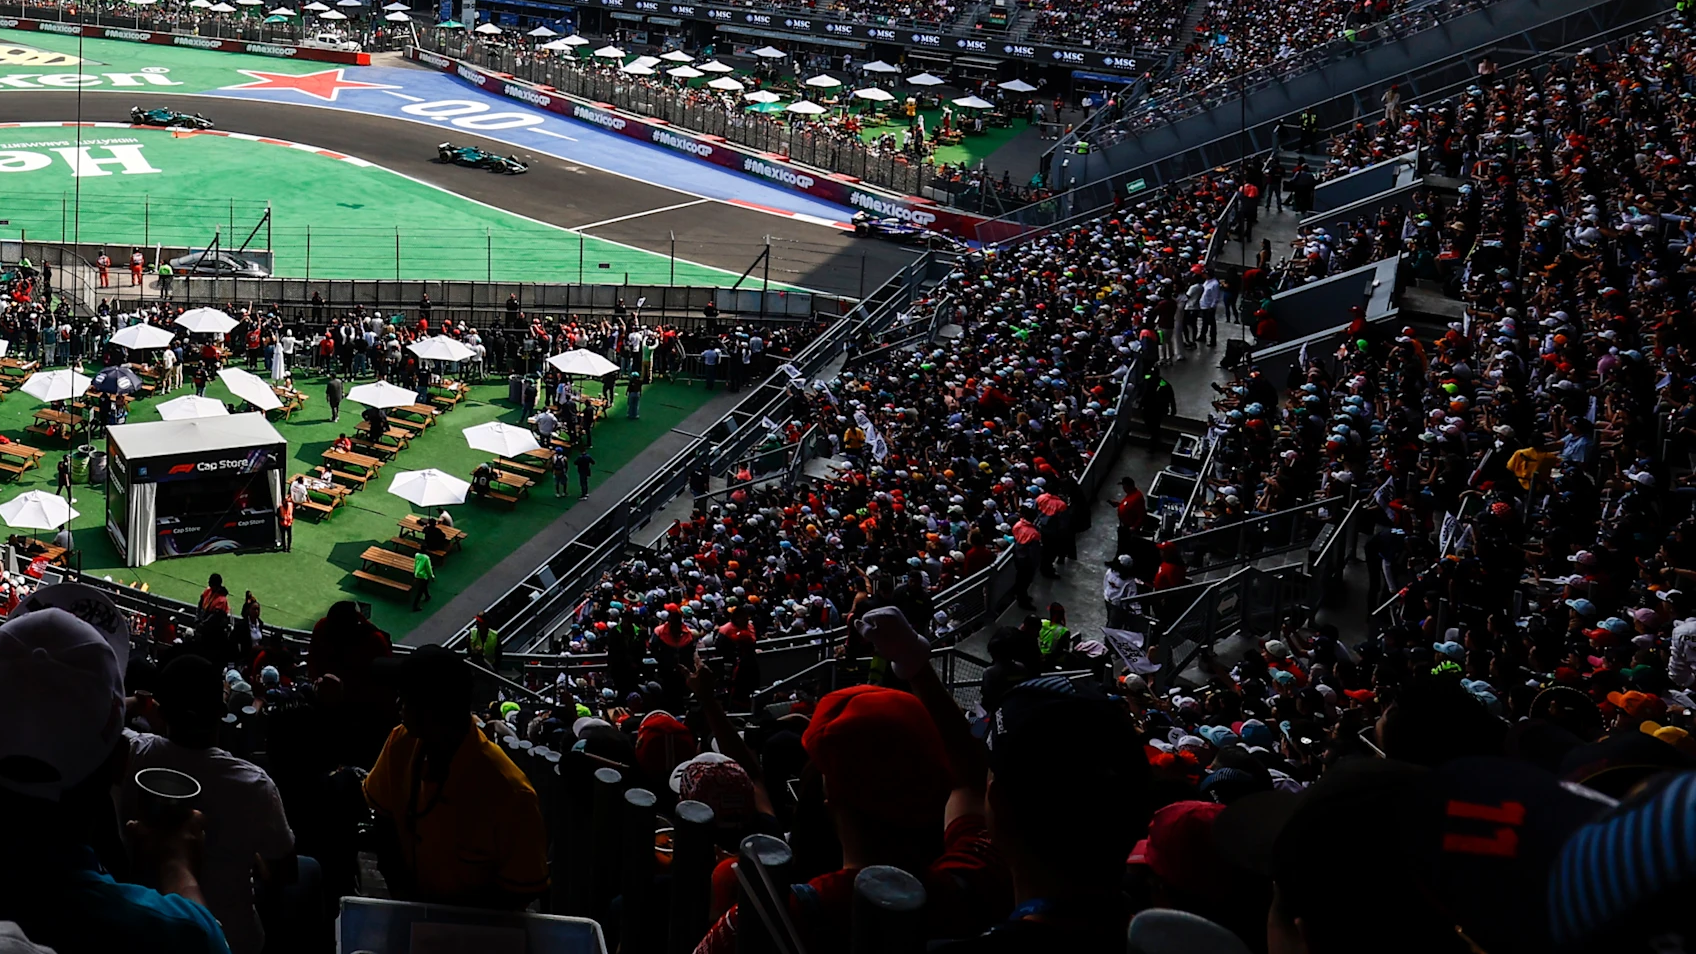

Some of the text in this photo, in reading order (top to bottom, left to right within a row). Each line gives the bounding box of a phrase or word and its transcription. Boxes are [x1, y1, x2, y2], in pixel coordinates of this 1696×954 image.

[104, 29, 151, 41] #MexicoGP
[174, 36, 222, 48] #MexicoGP
[246, 44, 297, 56] #MexicoGP
[418, 53, 450, 68] #MexicoGP
[458, 64, 487, 86] #MexicoGP
[504, 84, 551, 106] #MexicoGP
[573, 106, 626, 130] #MexicoGP
[652, 129, 713, 158] #MexicoGP
[744, 158, 814, 189] #MexicoGP
[850, 191, 936, 225] #MexicoGP
[197, 462, 217, 472] Cap
[219, 458, 249, 469] Store
[1443, 800, 1525, 857] 11
